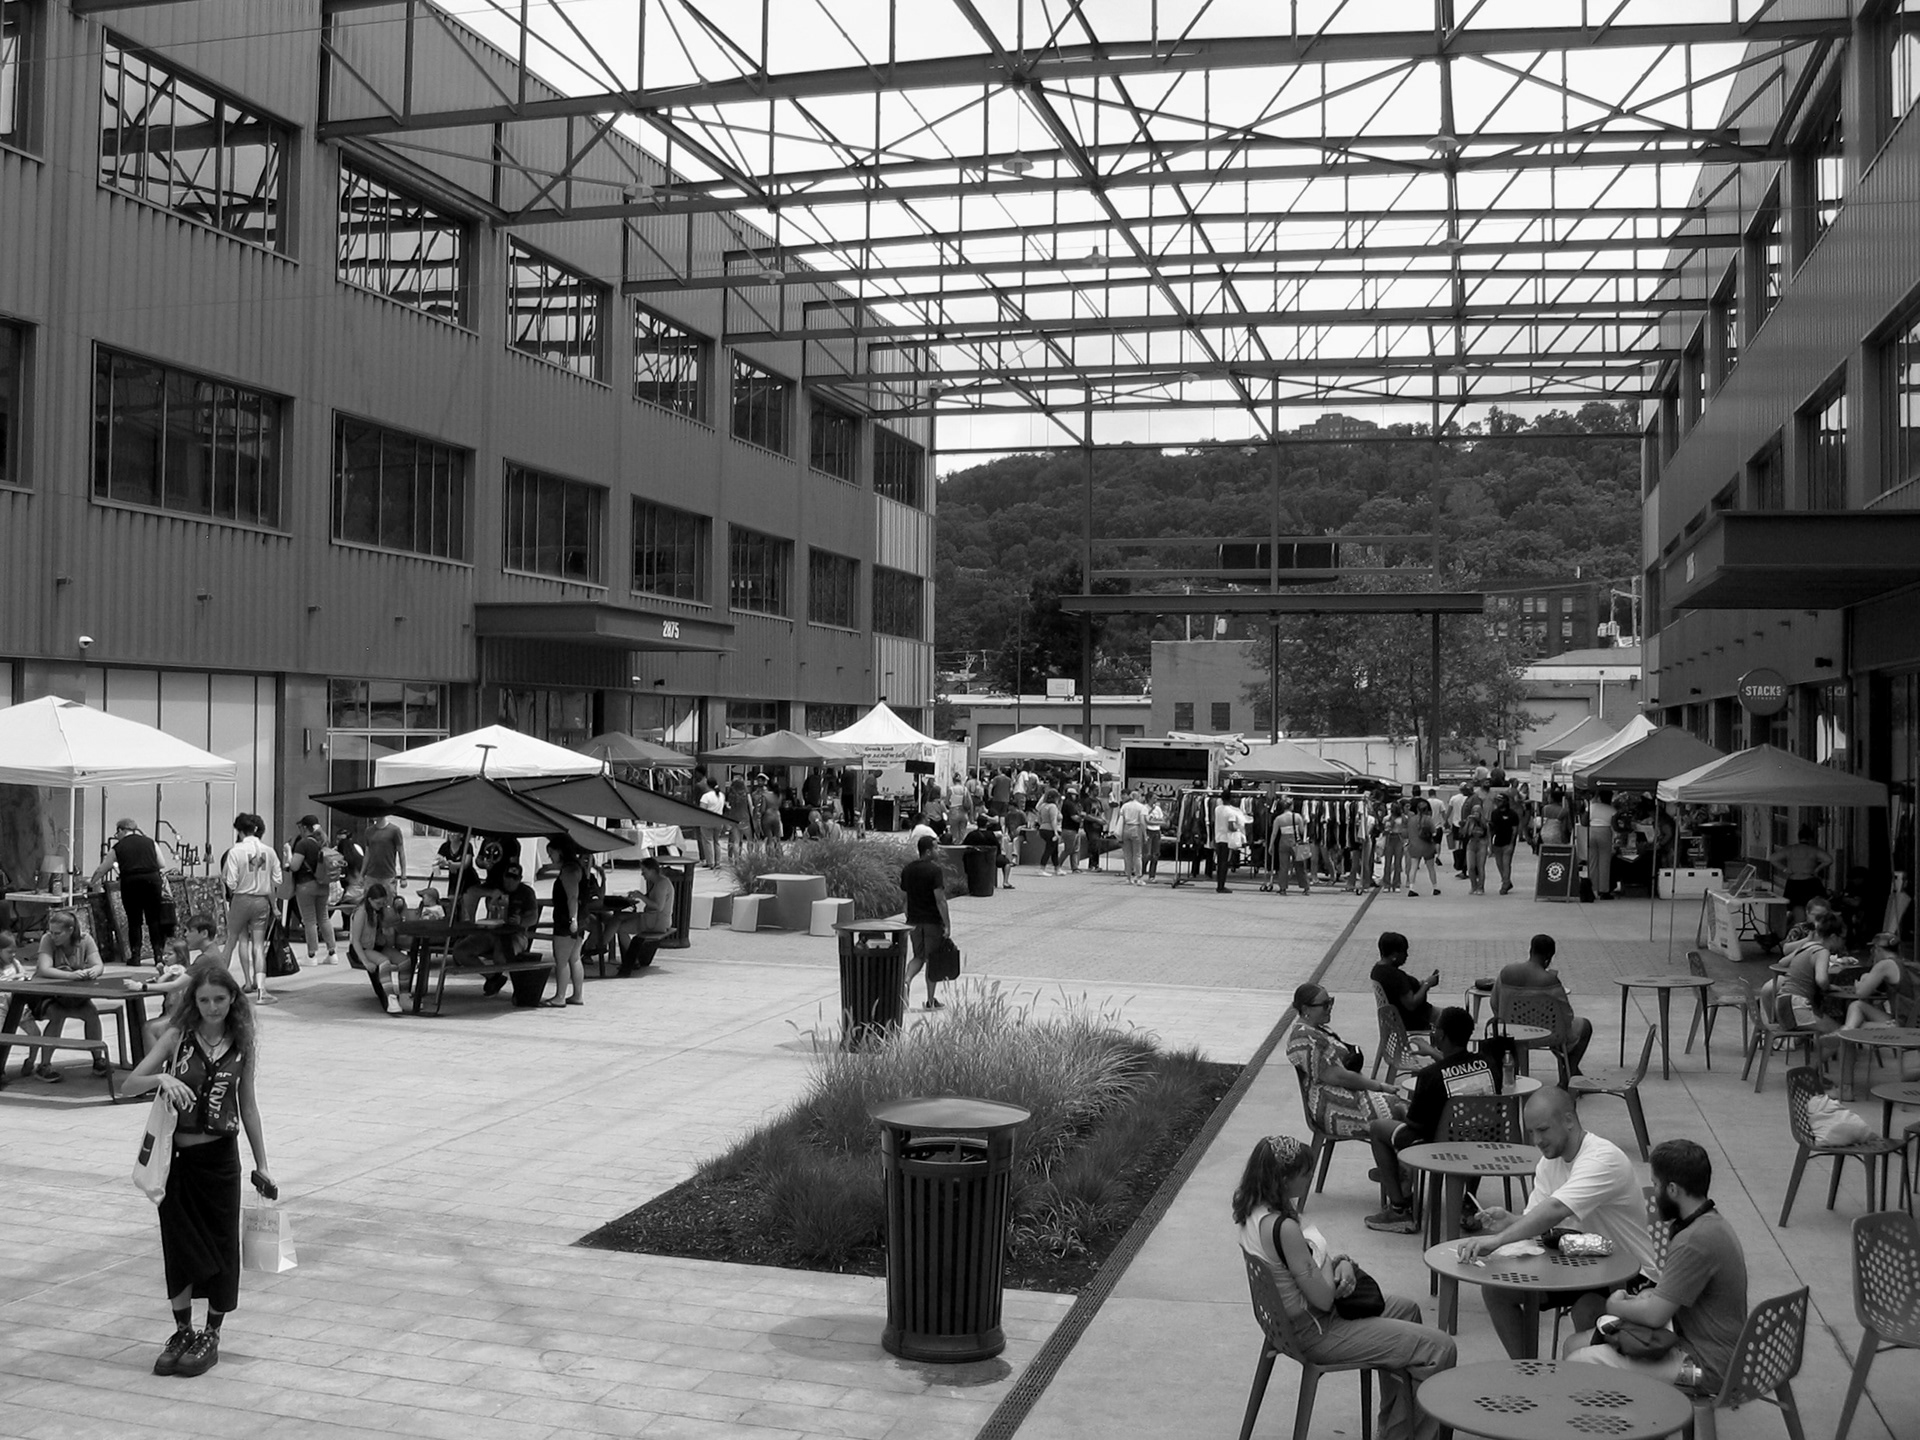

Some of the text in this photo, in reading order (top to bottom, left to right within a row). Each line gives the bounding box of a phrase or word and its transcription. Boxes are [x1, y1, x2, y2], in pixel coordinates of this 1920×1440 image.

[662, 620, 680, 639] 2875
[1745, 685, 1781, 696] STACKS
[1441, 1059, 1488, 1079] MONACO
[208, 1081, 230, 1111] VENT
